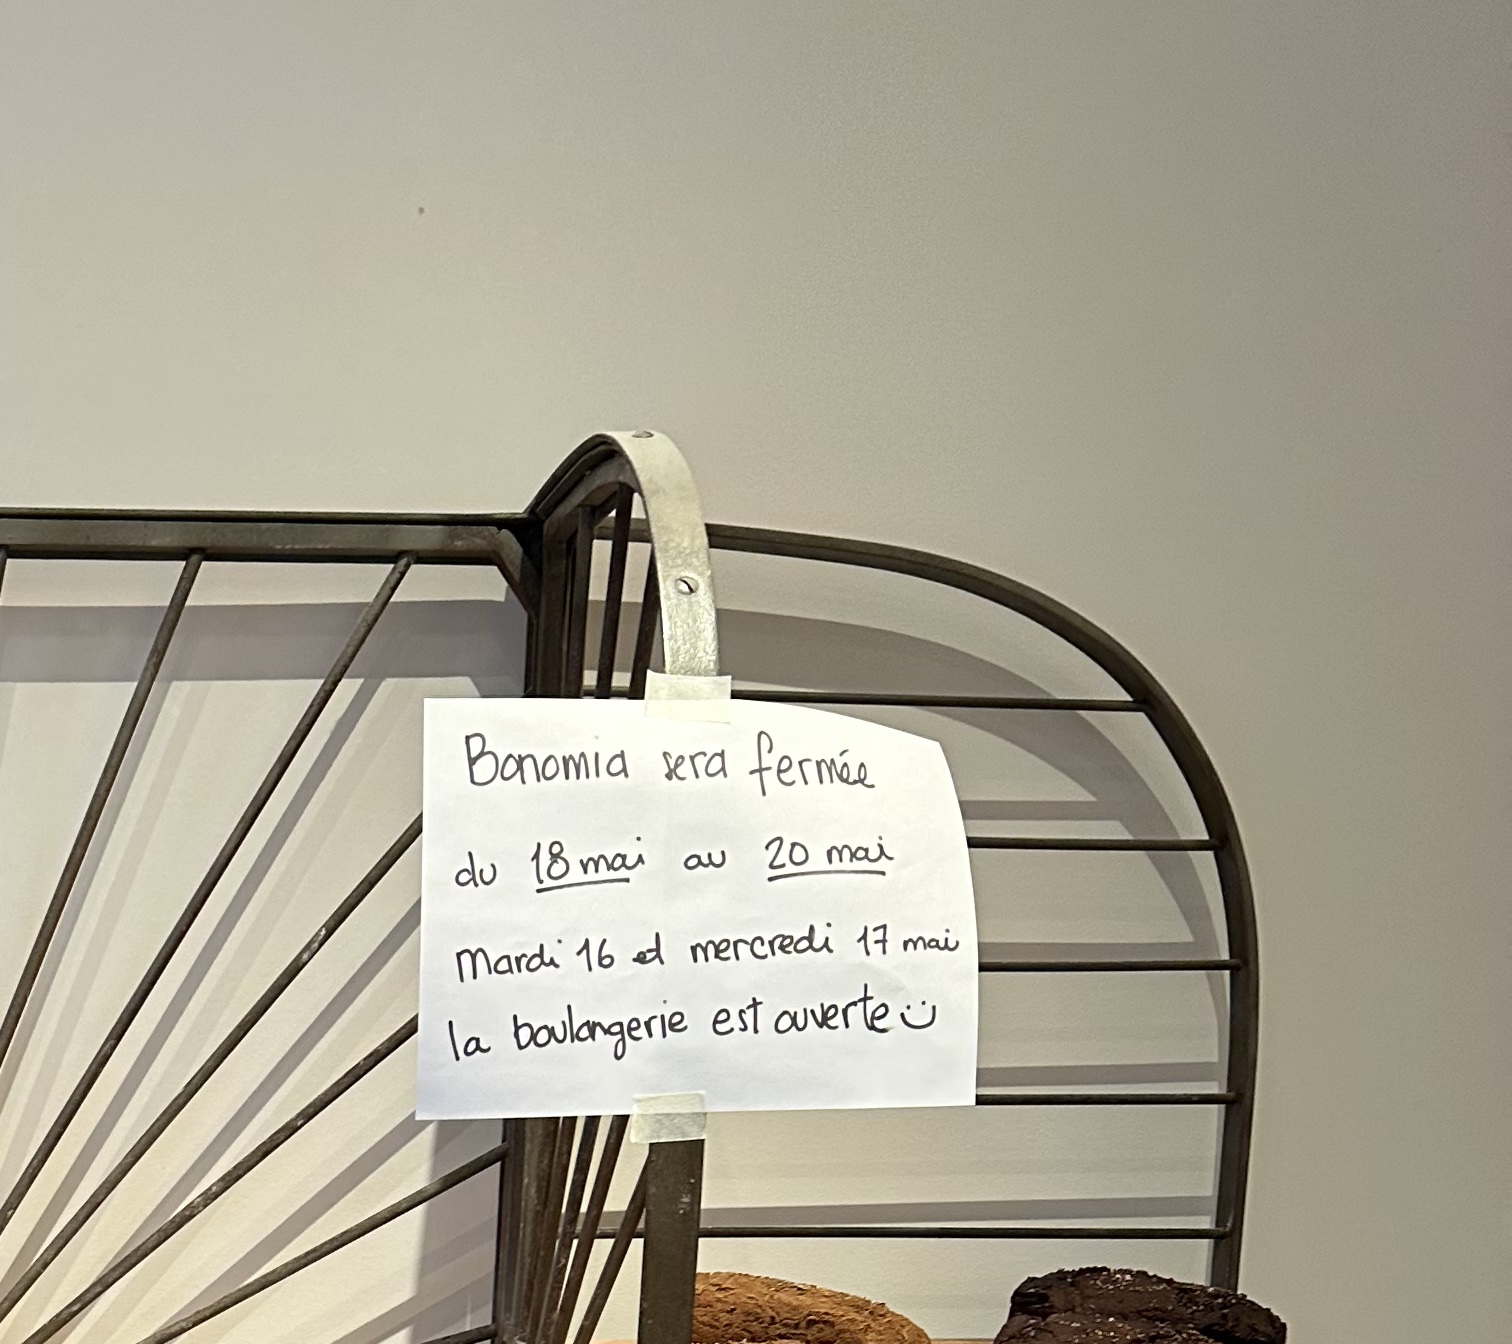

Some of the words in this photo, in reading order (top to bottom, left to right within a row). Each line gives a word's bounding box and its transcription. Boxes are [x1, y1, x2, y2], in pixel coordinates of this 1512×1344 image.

[465, 732, 630, 787] Bonomia
[664, 747, 728, 782] sera
[748, 731, 876, 796] fermée
[455, 852, 497, 888] du
[531, 841, 570, 884] 18
[580, 837, 645, 872] mai
[684, 850, 727, 871] au
[767, 837, 809, 868] 20
[827, 835, 895, 864] mai
[576, 941, 615, 973] 16
[633, 932, 665, 966] et
[690, 923, 834, 964] mercredi
[857, 927, 889, 957] 17
[903, 927, 960, 952] mai
[448, 1020, 491, 1062] la
[513, 1001, 689, 1060] boulangerie
[712, 996, 761, 1036] est
[774, 984, 890, 1035] ouverte
